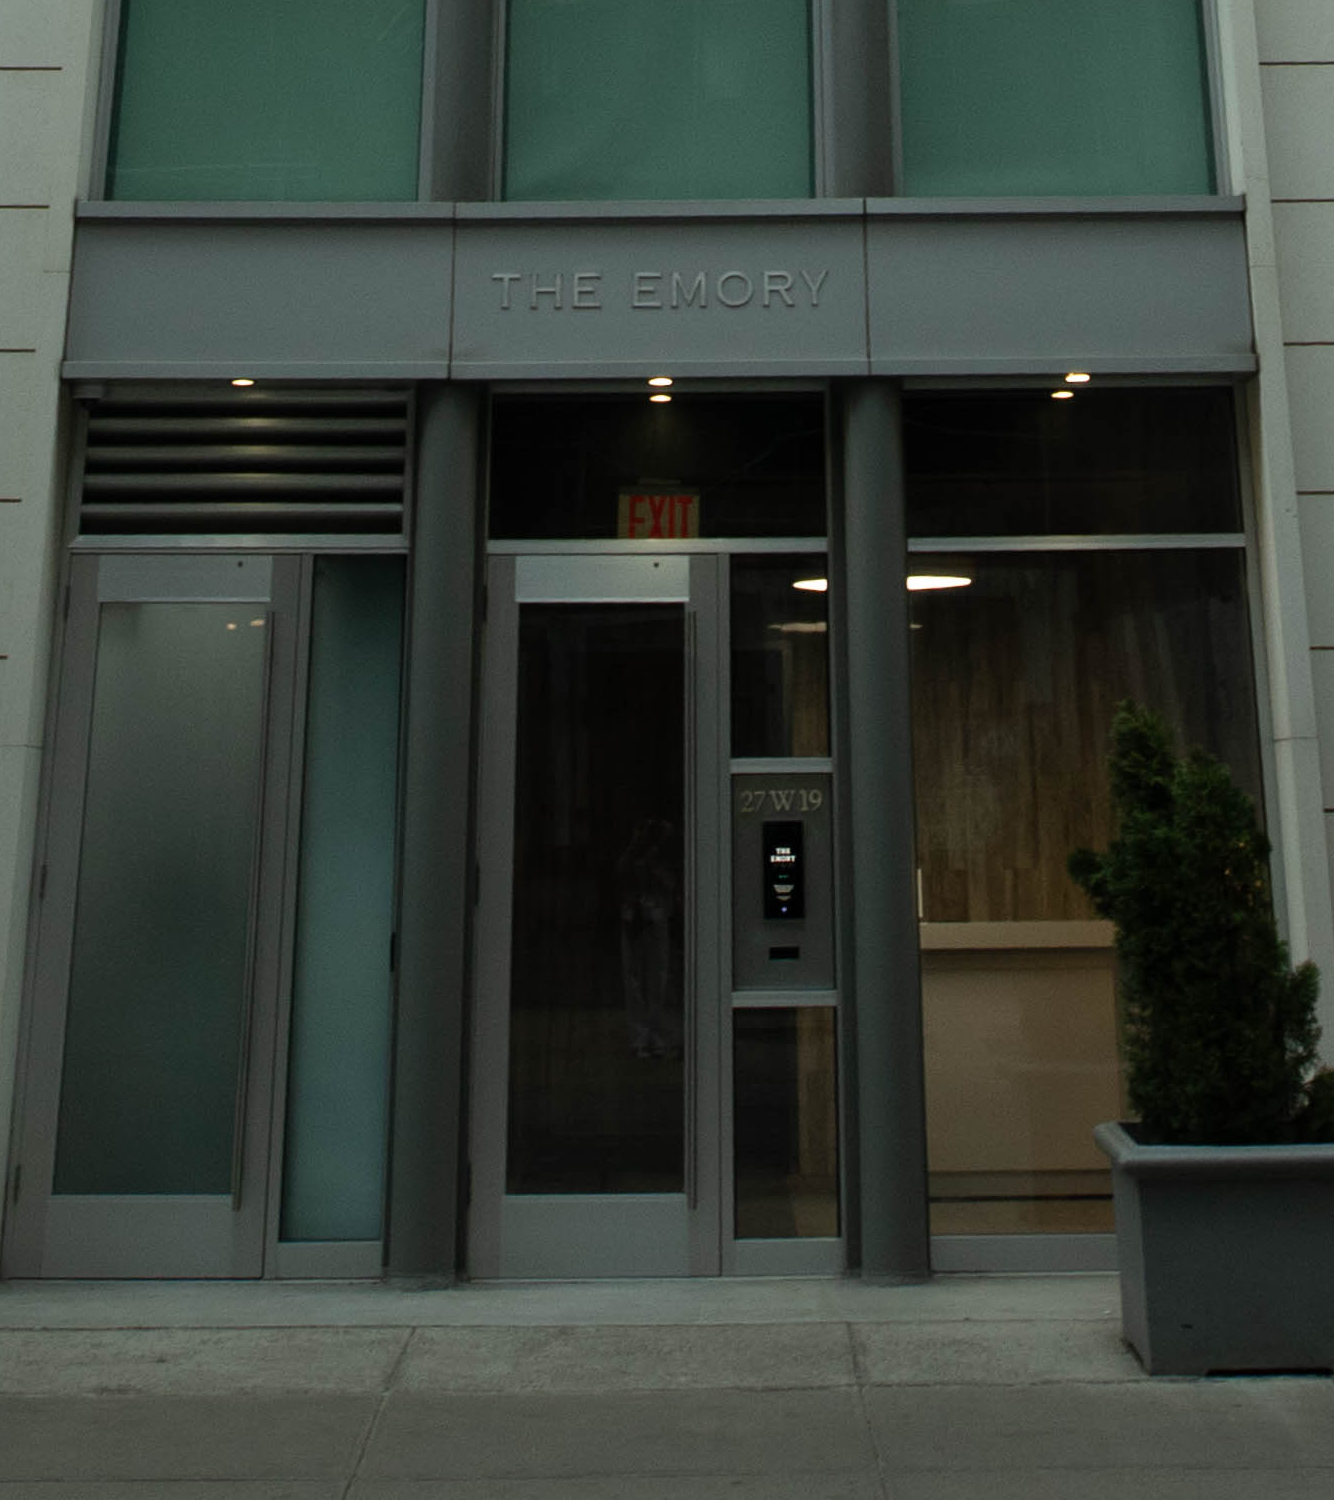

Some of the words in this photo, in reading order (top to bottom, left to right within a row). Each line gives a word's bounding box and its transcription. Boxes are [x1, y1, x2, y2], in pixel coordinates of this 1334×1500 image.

[491, 272, 603, 311] THE
[631, 268, 831, 309] EMORY
[627, 494, 696, 539] EXIT
[740, 790, 766, 813] 27
[769, 789, 796, 812] W
[798, 788, 823, 812] 19
